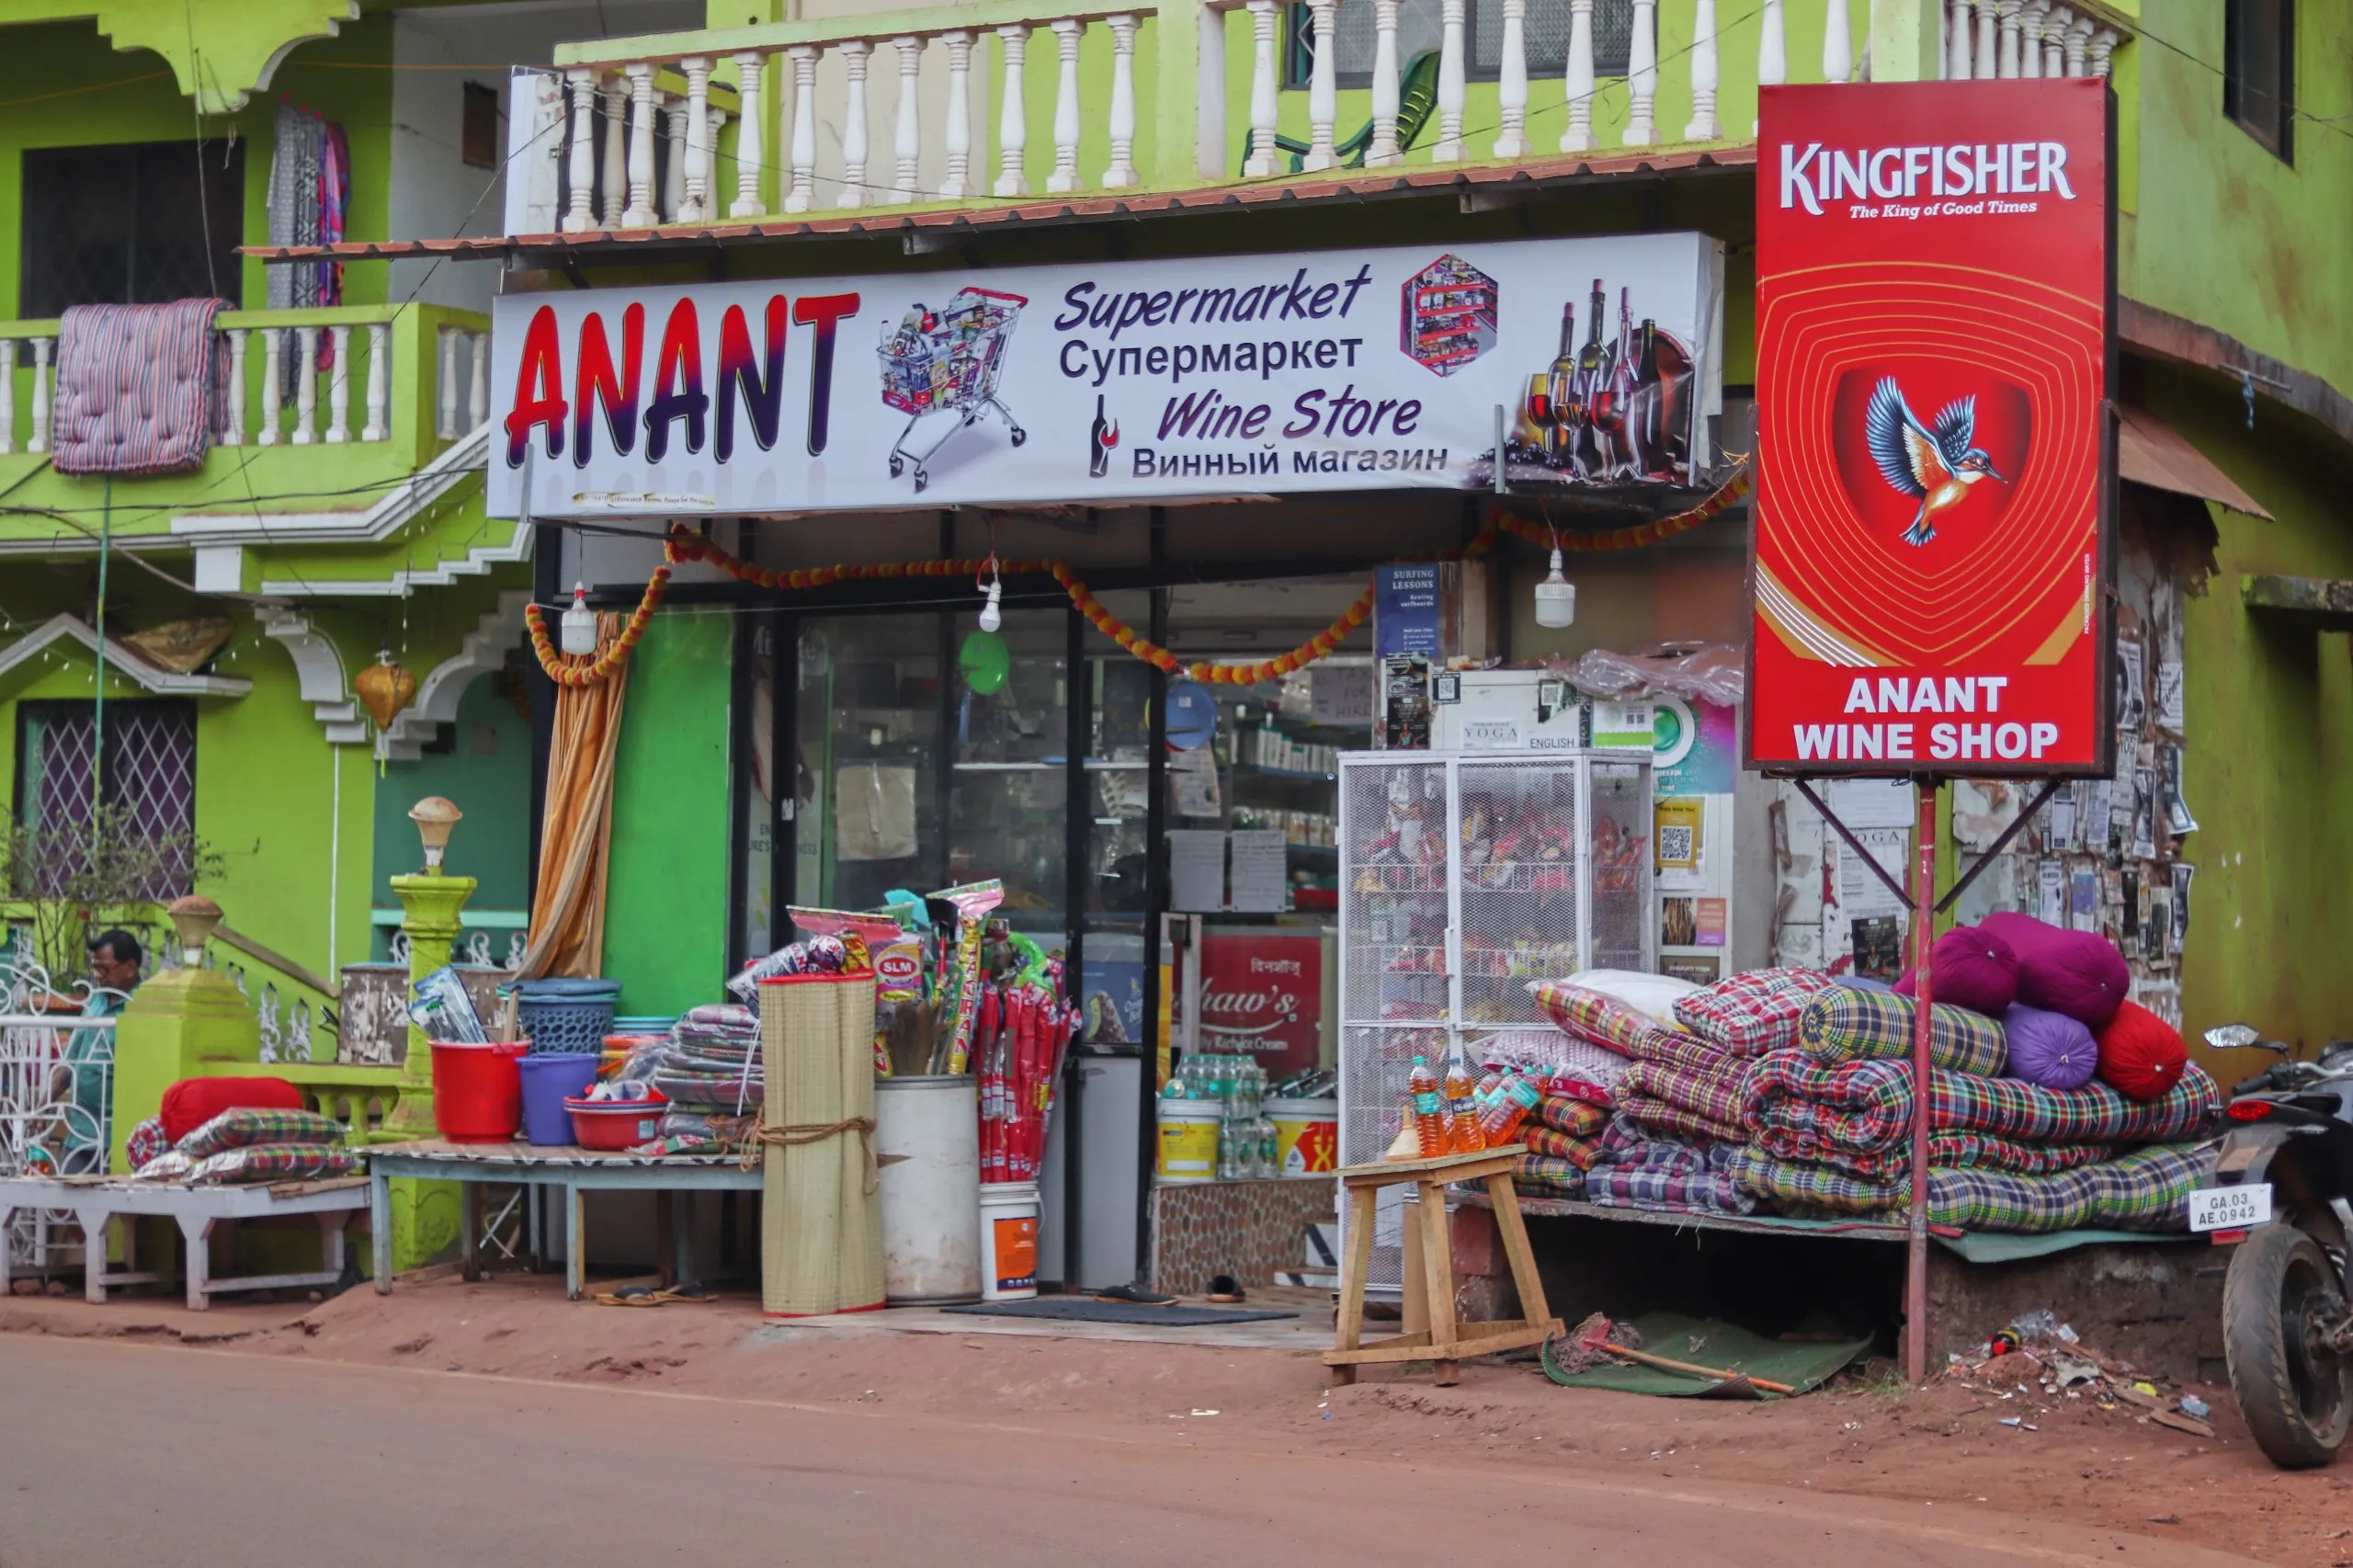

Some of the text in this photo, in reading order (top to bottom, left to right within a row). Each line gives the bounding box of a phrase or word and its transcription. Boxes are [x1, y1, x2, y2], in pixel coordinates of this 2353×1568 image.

[1780, 142, 2077, 216] KINGFISHER
[1849, 199, 2038, 221] The King of Good Times
[1054, 265, 1372, 341] Supermarket
[1059, 335, 1364, 386] Супермаркет
[505, 292, 860, 468] ANANT
[1156, 384, 1423, 442] Wine Store
[1131, 443, 1449, 480] Винный магазин
[1392, 580, 1434, 590] LESSONS
[1393, 570, 1434, 579] SURFING
[1844, 676, 2007, 714] ANANT
[1463, 727, 1518, 739] YOGA
[1529, 738, 1574, 749] ENGLISH
[1793, 722, 2059, 760] WINE SHOP
[883, 960, 913, 973] SLM
[1199, 977, 1301, 1015] haw's
[2199, 1206, 2256, 1225] AE.0942
[2210, 1193, 2248, 1210] GA.03
